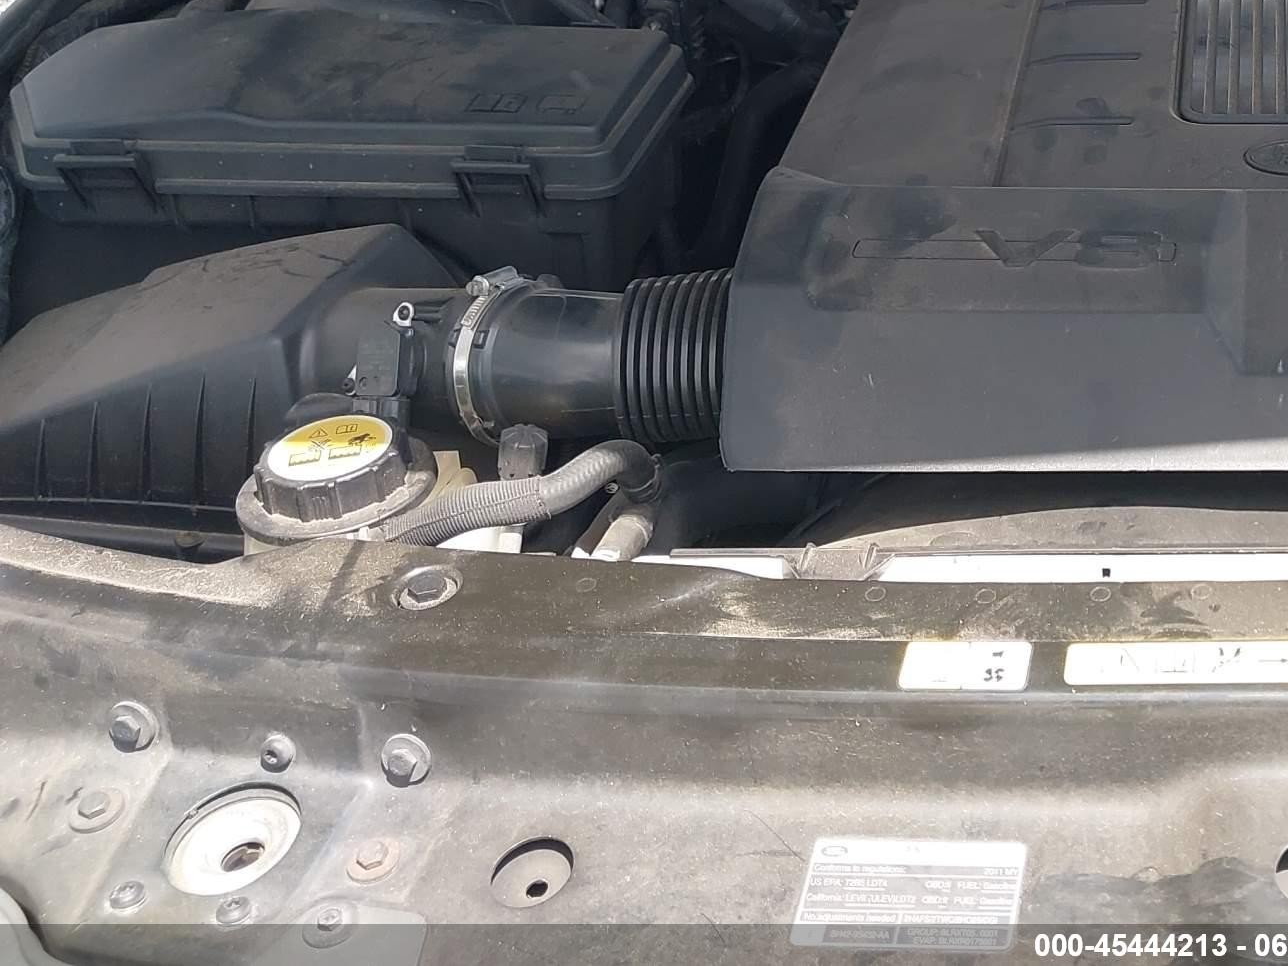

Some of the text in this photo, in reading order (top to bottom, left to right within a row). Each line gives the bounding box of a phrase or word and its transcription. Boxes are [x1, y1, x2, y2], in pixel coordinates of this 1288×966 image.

[813, 864, 851, 873] Conforms
[810, 876, 822, 886] US
[866, 913, 897, 923] needed
[907, 927, 939, 937] GROUP:
[912, 937, 937, 945] EVAP:
